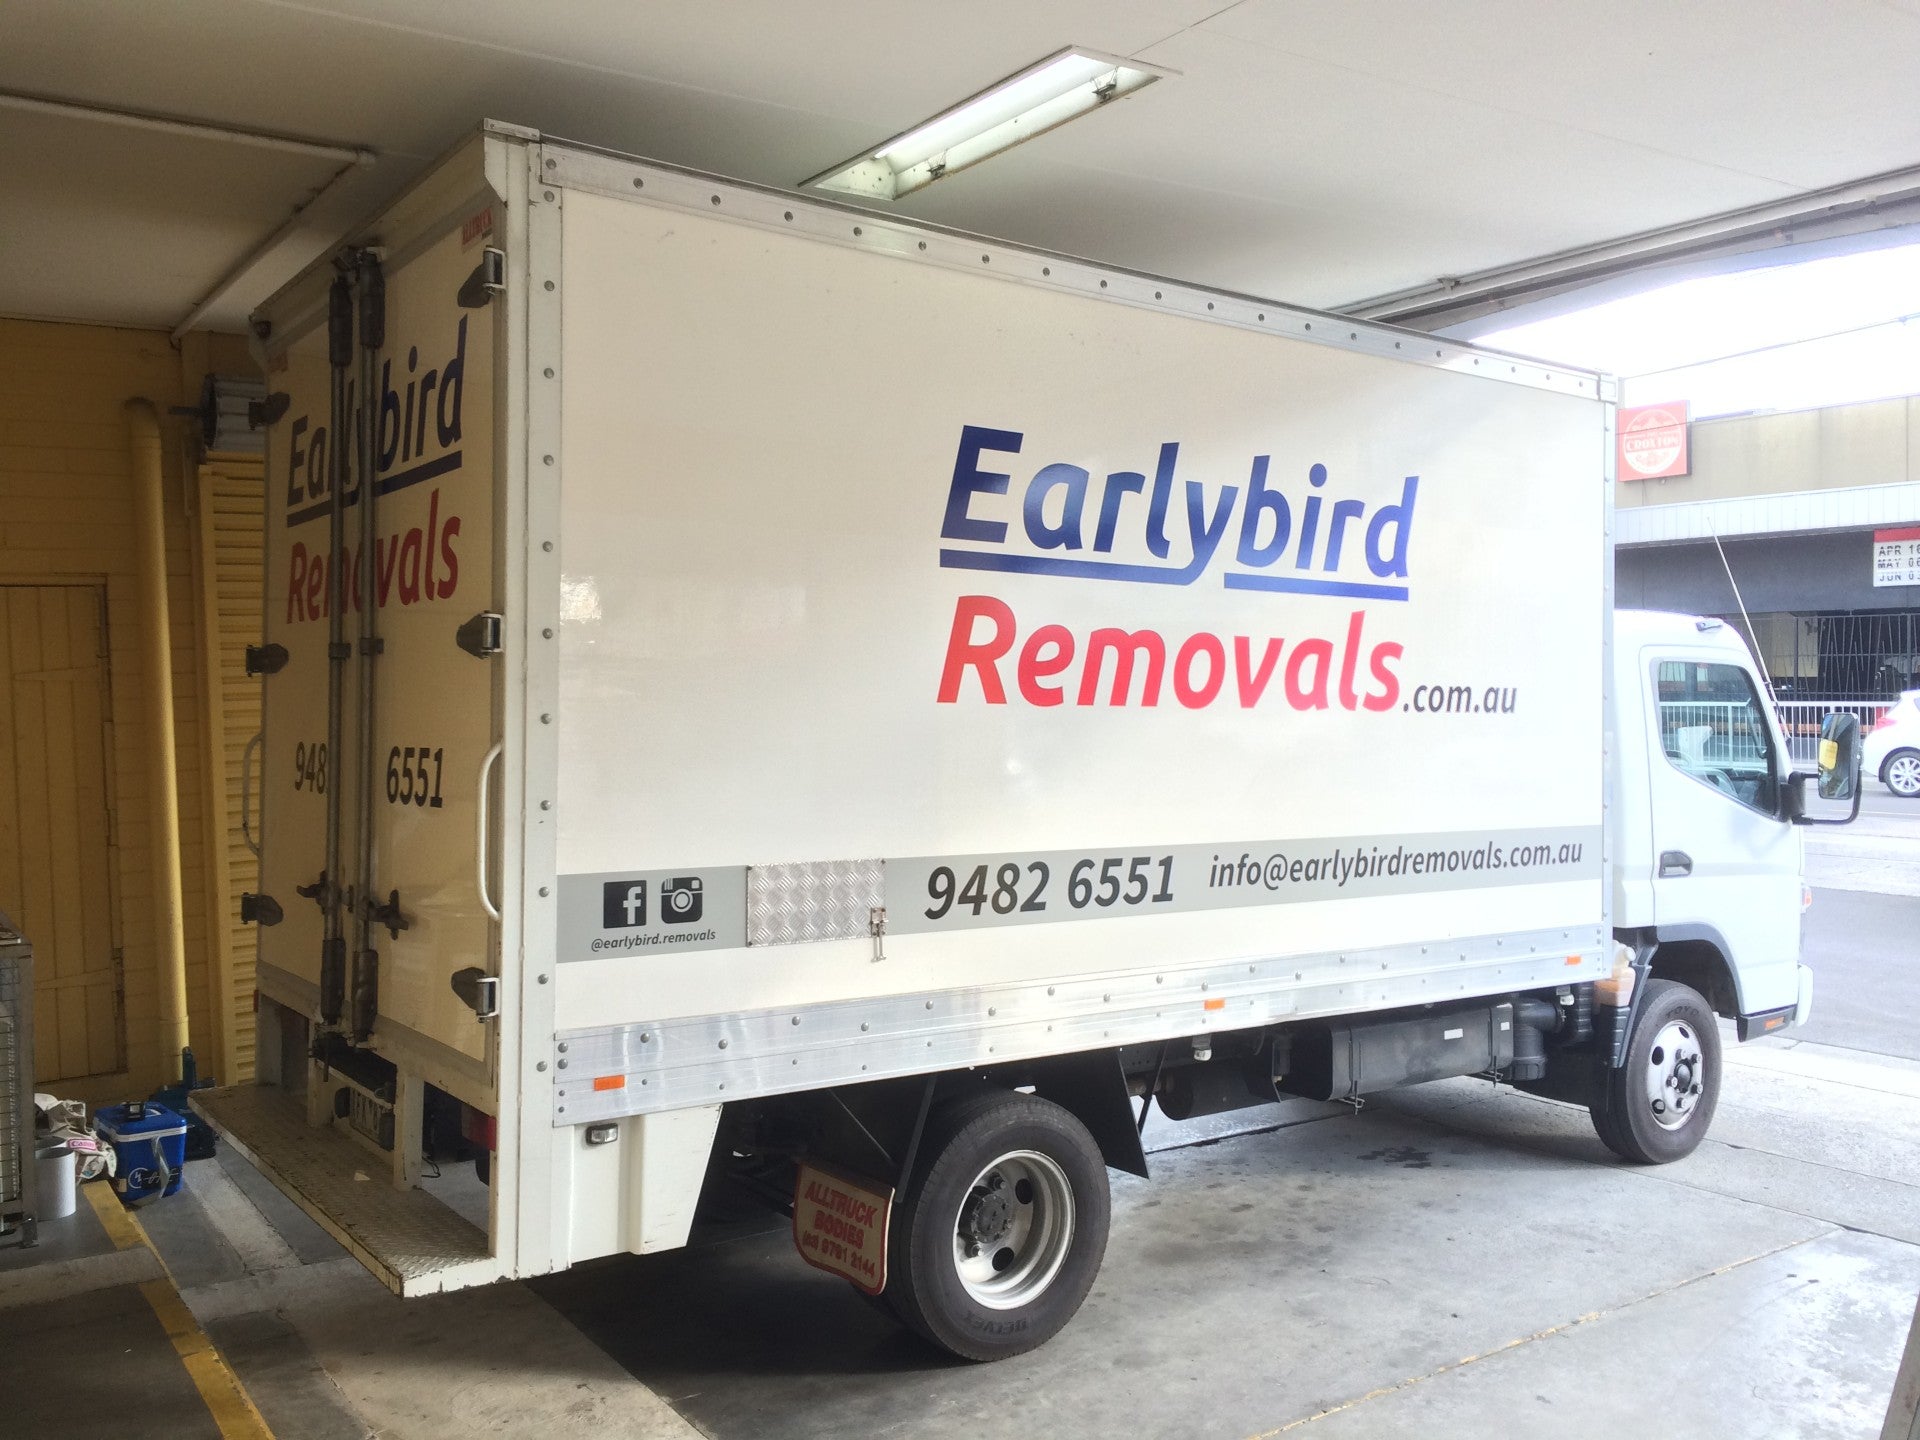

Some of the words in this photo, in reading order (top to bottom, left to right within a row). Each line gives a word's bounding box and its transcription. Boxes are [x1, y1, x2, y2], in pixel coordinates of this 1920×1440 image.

[287, 314, 468, 508] Ealybird
[1626, 436, 1680, 451] CROXTON
[940, 424, 1420, 586] Earlybird
[1877, 558, 1901, 569] MAY
[1879, 544, 1902, 556] APR
[1879, 571, 1902, 582] JUN
[294, 741, 329, 795] 948
[386, 745, 444, 809] 6551
[924, 860, 1051, 920] 9482
[1067, 854, 1176, 909] 6551
[1208, 840, 1583, 891] info@earlybirdremovals.com.au
[591, 929, 716, 952] @earlybird.removals
[804, 1181, 878, 1229] ALLTRUCK
[814, 1210, 865, 1249] BODIES
